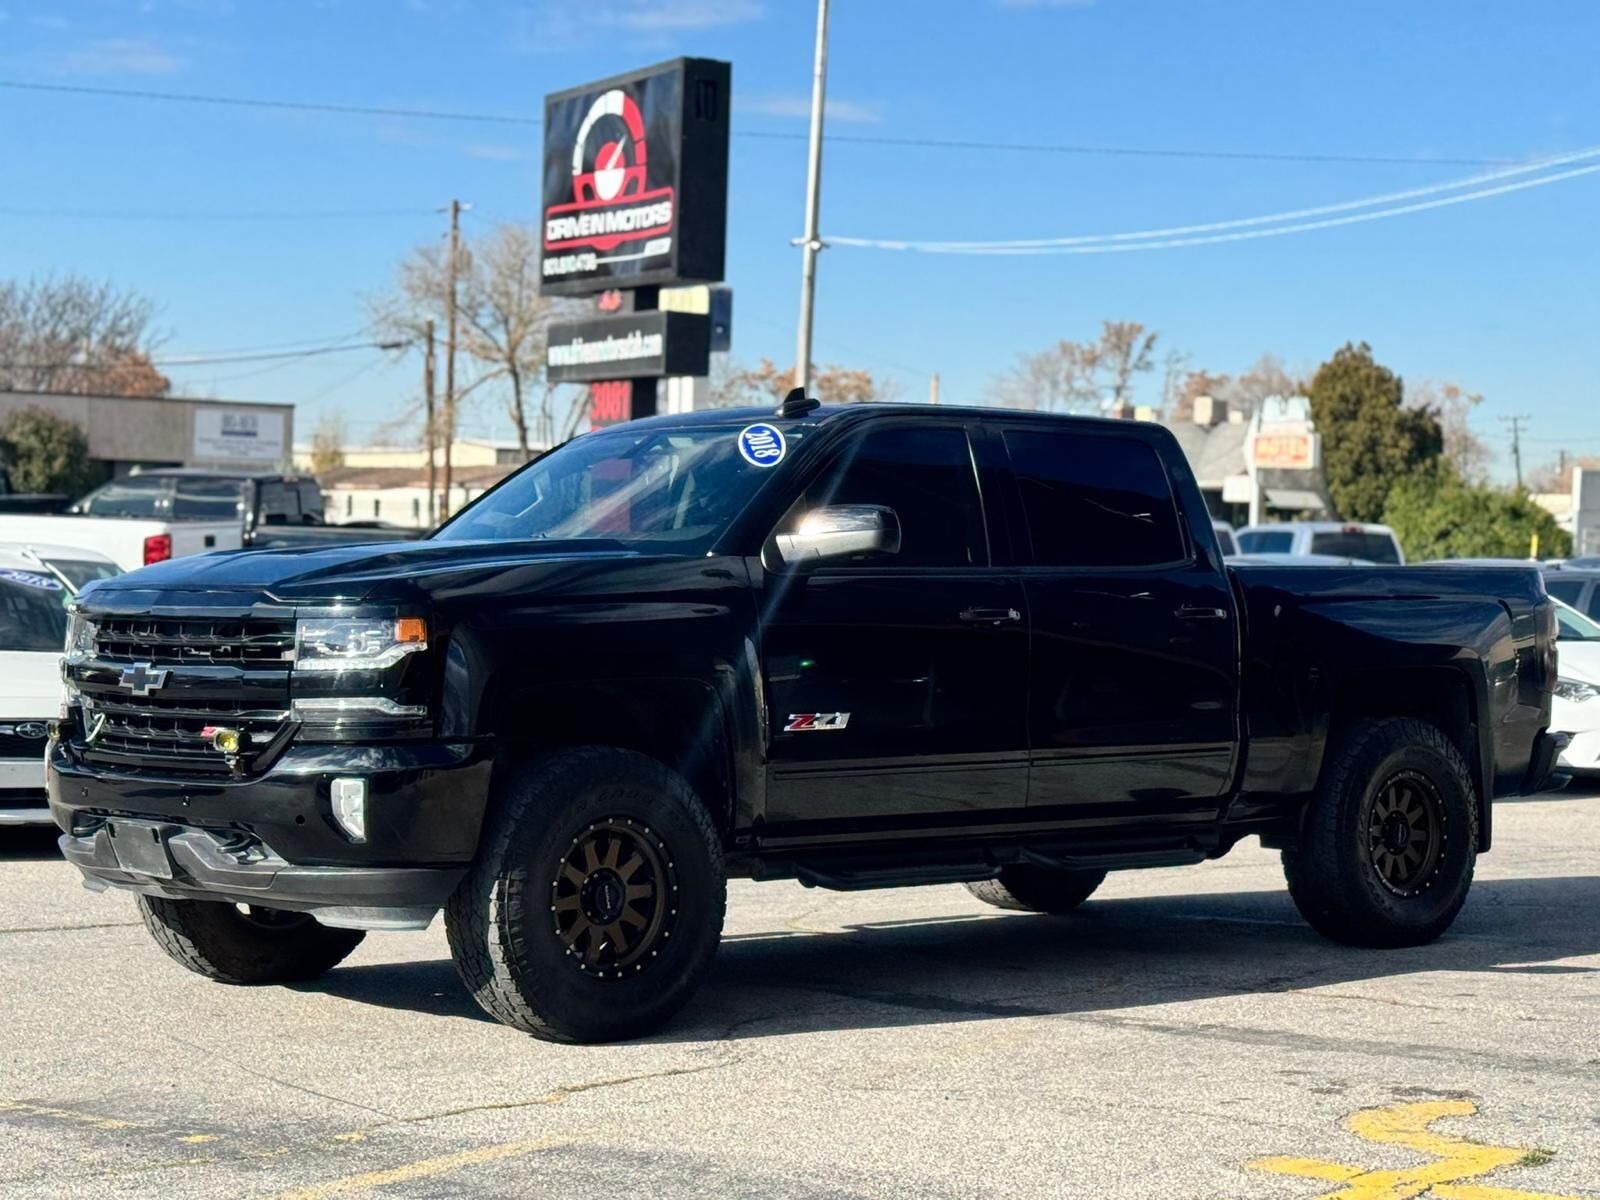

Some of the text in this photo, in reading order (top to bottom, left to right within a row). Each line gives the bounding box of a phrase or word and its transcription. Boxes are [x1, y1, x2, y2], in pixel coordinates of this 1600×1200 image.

[546, 201, 672, 241] DRIVEN MOTORS
[745, 429, 780, 458] 2018
[784, 711, 851, 731] Z71
